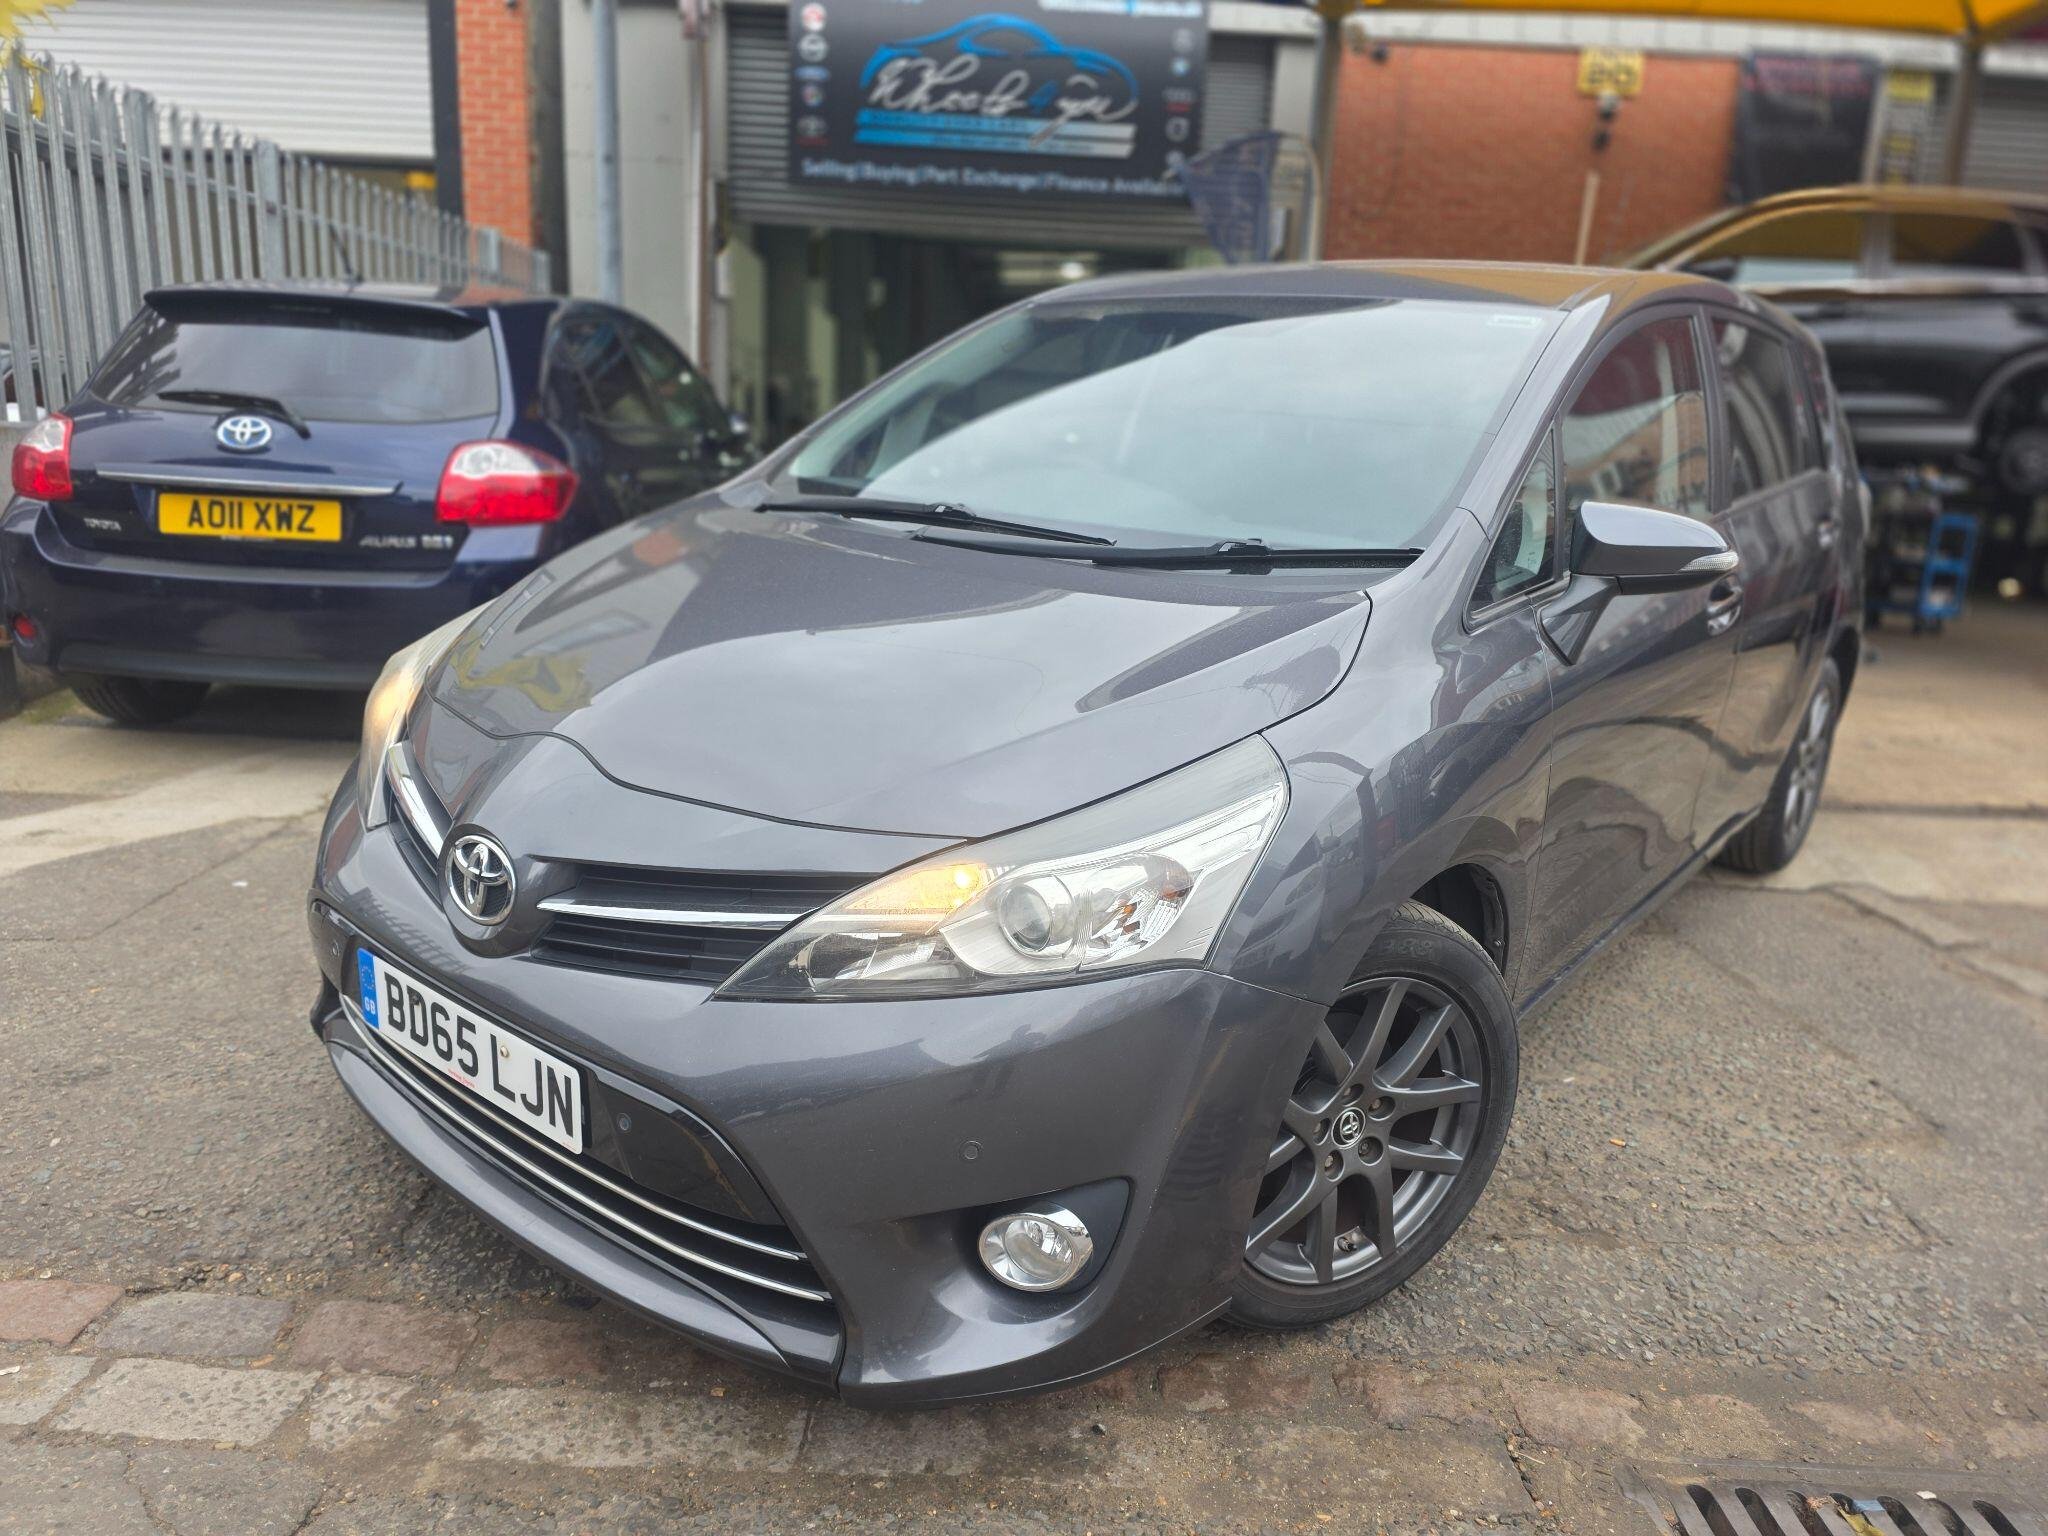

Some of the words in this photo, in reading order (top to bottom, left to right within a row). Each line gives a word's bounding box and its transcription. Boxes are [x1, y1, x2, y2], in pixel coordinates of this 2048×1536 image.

[84, 517, 121, 531] TOYOTA
[254, 503, 315, 533] XWZ
[364, 997, 376, 1015] GB
[384, 971, 479, 1078] BD65
[490, 1033, 574, 1138] LJN
